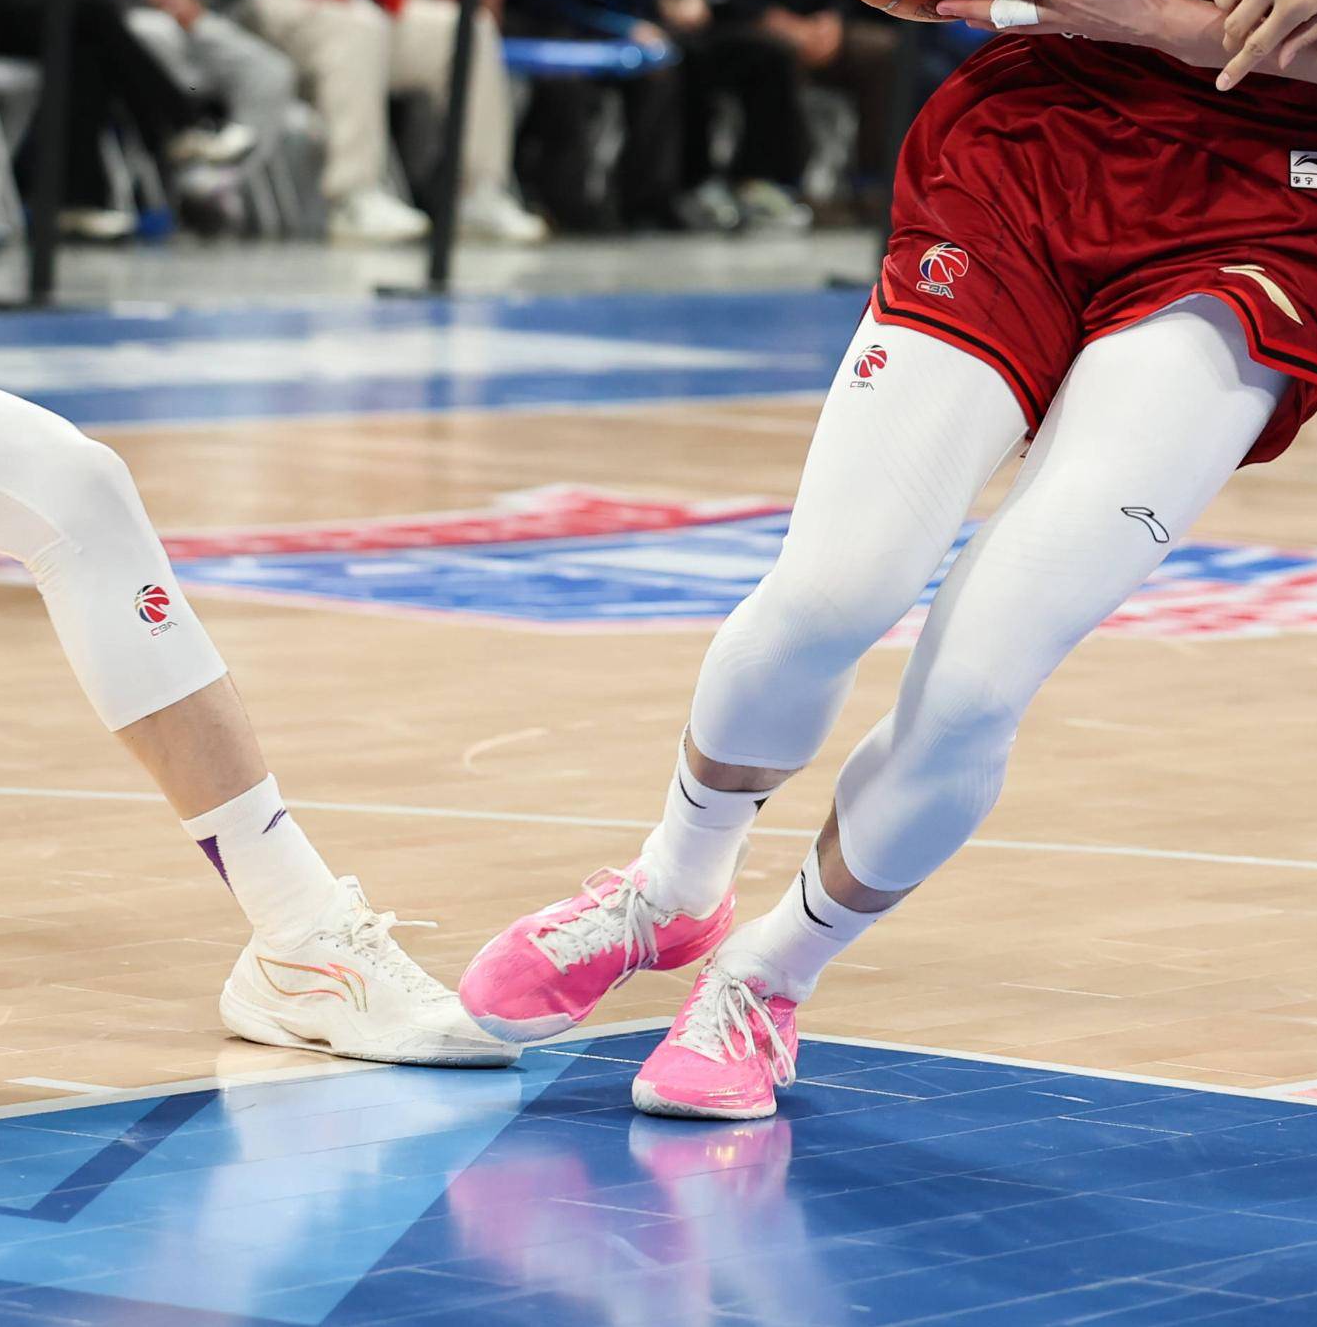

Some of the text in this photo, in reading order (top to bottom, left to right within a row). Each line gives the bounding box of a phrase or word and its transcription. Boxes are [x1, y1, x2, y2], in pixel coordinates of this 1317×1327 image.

[916, 281, 954, 299] CBA
[850, 381, 874, 391] CBA
[150, 621, 178, 637] CBA
